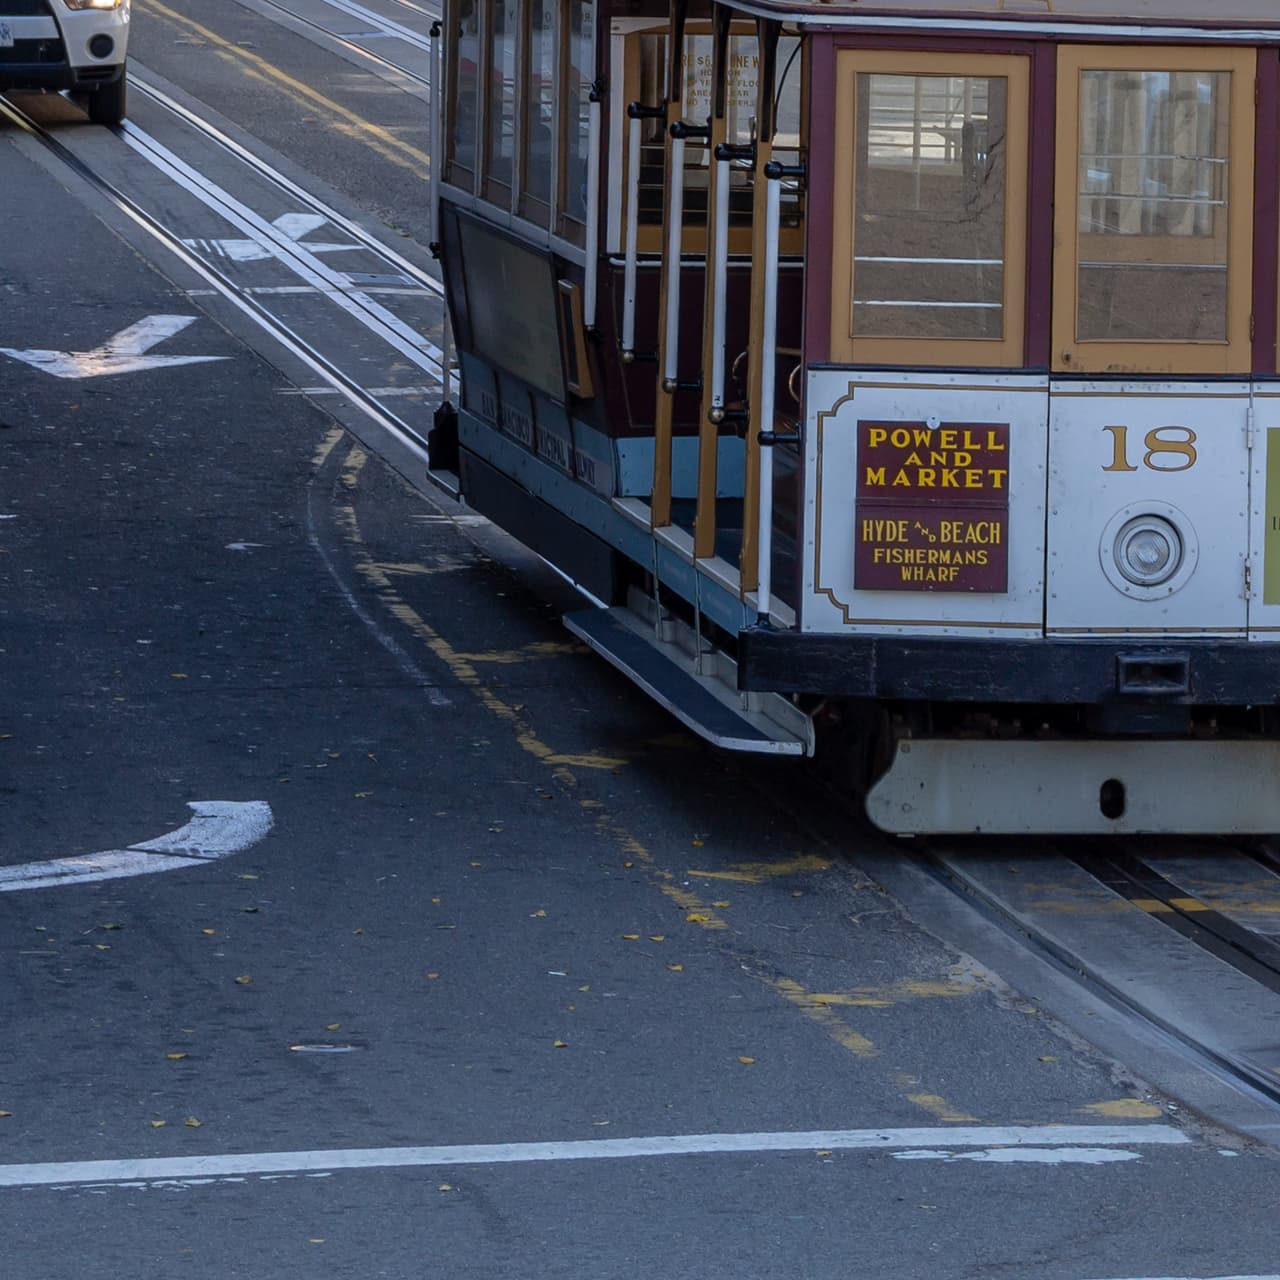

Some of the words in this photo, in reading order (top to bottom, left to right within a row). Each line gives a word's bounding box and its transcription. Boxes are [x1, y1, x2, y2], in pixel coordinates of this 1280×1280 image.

[869, 428, 1005, 450] POWELL
[1101, 426, 1197, 472] 18
[904, 451, 972, 467] AND
[865, 467, 1007, 488] MARKET
[863, 519, 909, 542] HYDE
[914, 521, 936, 543] AND
[940, 521, 1001, 544] BEACH
[874, 548, 988, 564] FISHERMANS
[901, 566, 960, 581] WHARF
